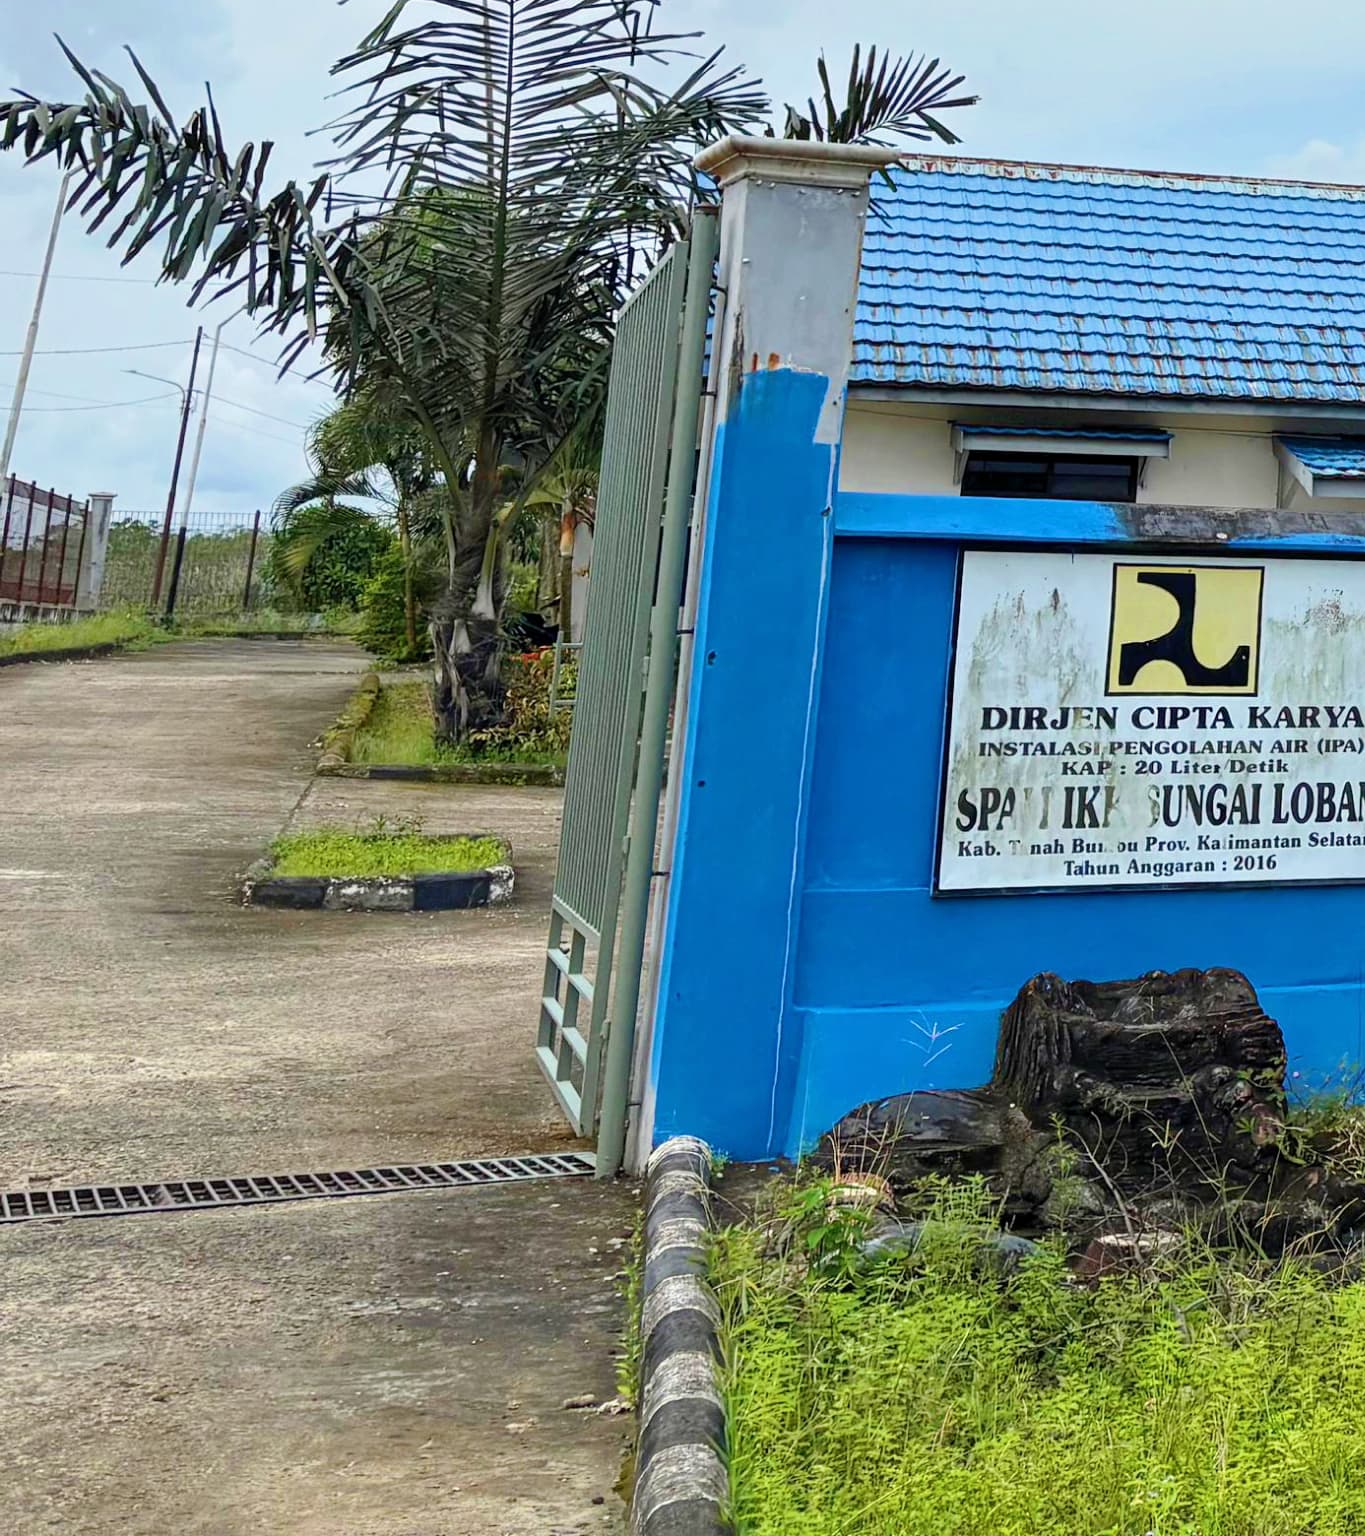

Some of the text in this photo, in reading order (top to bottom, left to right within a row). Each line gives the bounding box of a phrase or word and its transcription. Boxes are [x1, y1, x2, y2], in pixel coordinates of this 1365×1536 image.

[980, 705, 1365, 730] DIRJEN CIPTA KARYA
[978, 737, 1365, 757] INSTALASI PENGOLAHAN AIR (IPA)
[1061, 761, 1112, 776] KAP
[1134, 760, 1163, 775] 20
[958, 840, 1001, 857] Kab.
[1009, 839, 1064, 856] Tnah
[1145, 835, 1190, 853] Prov.
[1064, 859, 1120, 876] Tahun
[1127, 858, 1215, 877] Anggaran
[1233, 854, 1277, 871] 2016
